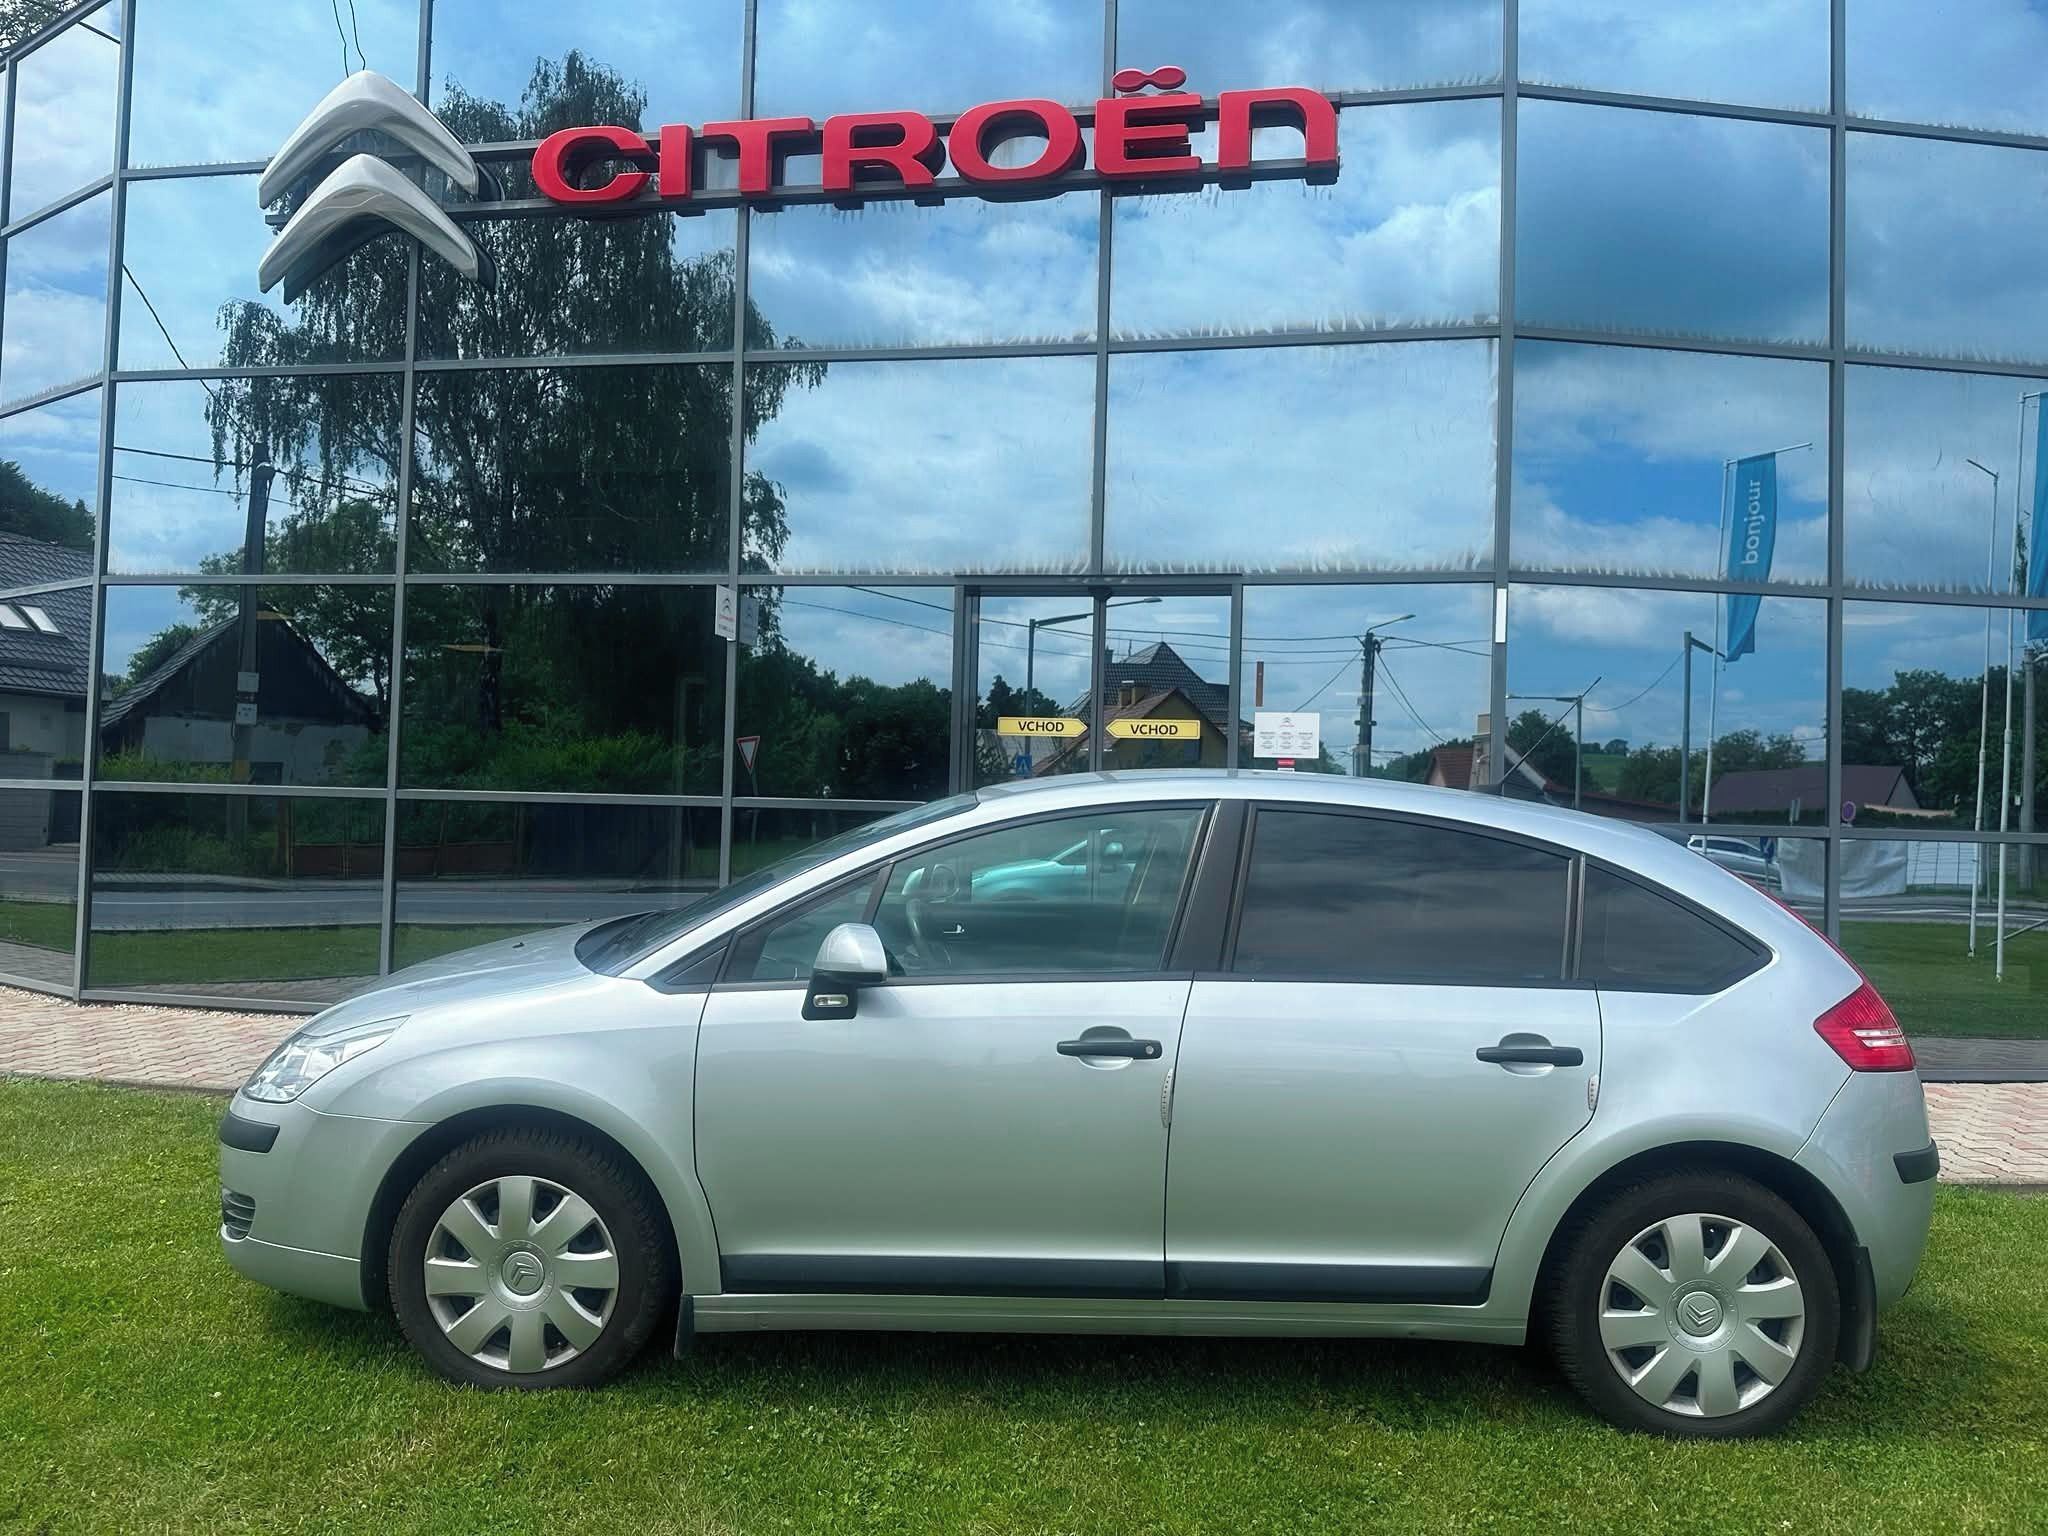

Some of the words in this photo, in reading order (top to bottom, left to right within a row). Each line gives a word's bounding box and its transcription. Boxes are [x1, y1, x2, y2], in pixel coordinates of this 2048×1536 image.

[531, 65, 1340, 203] CITROËN
[1740, 479, 1765, 565] bonjour
[1017, 720, 1065, 733] VCHOD
[1130, 723, 1179, 736] VCHOD
